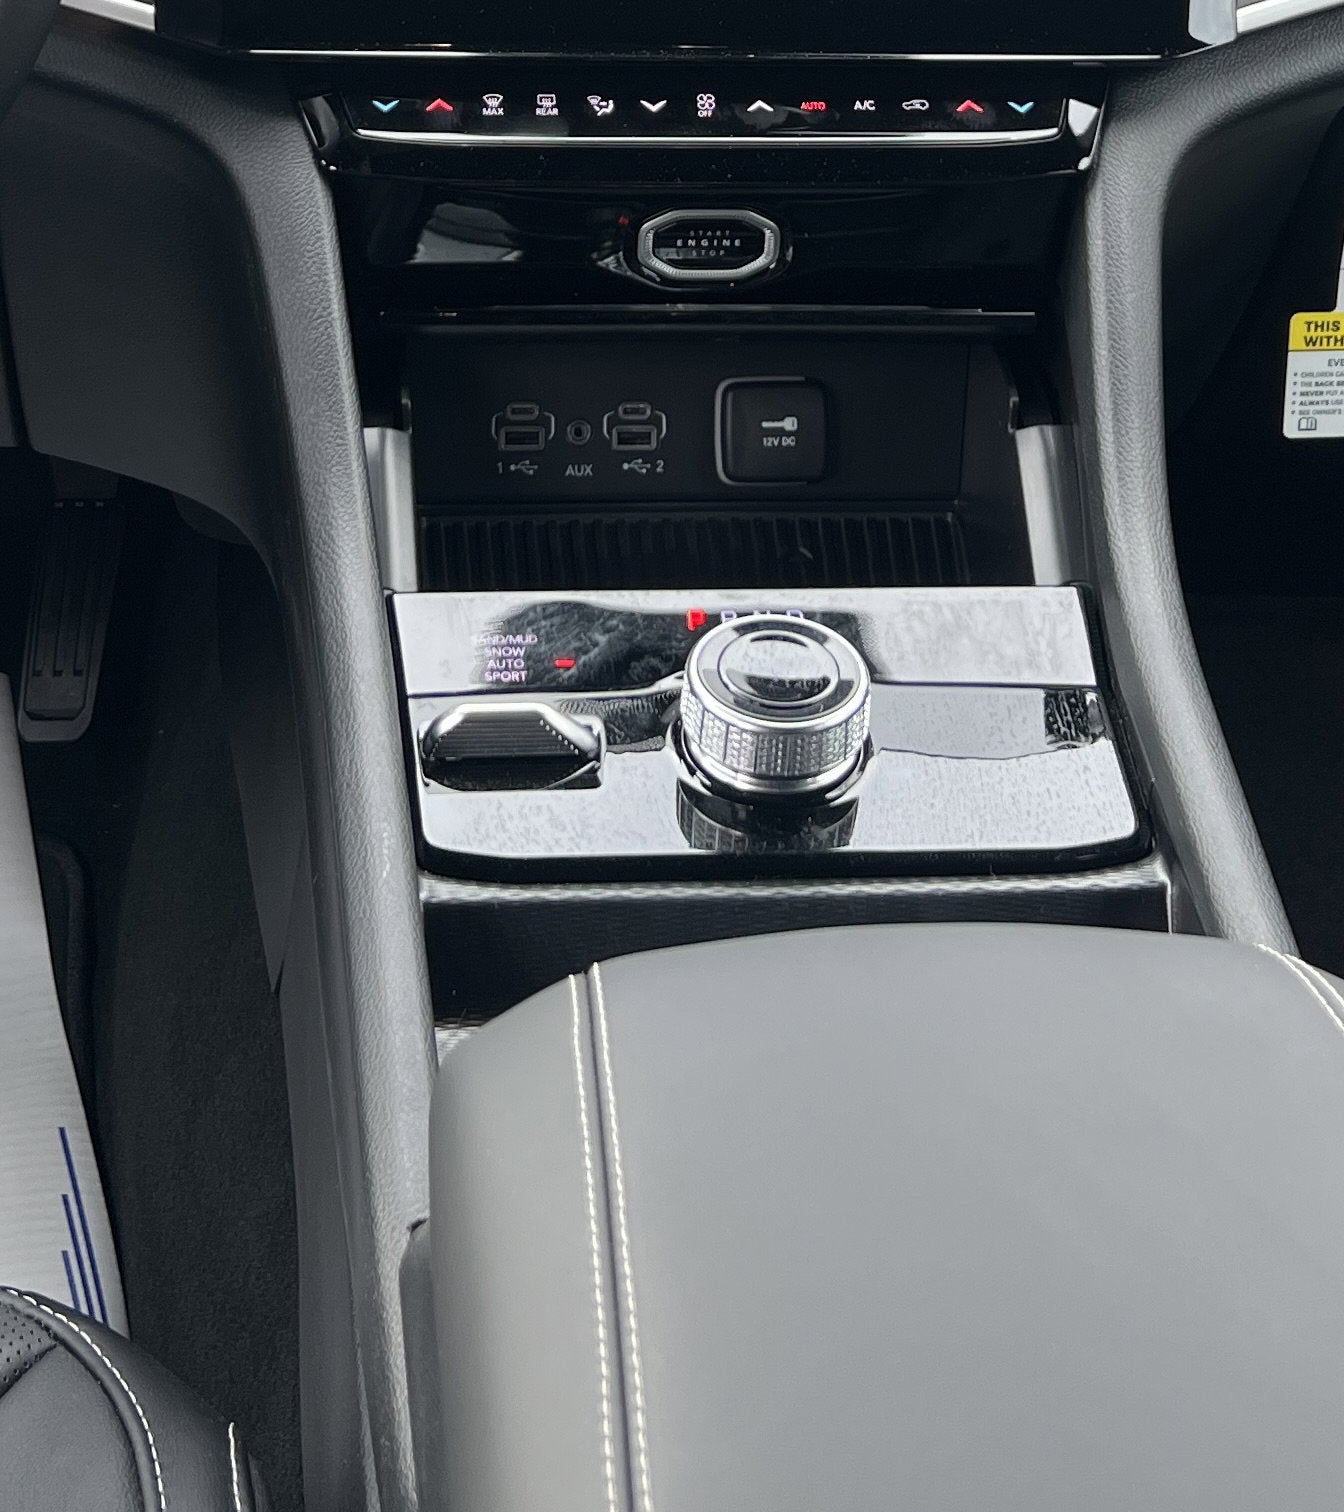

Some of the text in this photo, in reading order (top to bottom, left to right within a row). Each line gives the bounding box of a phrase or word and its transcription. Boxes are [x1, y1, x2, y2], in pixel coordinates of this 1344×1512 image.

[482, 105, 505, 116] MAX
[535, 105, 559, 116] REAR
[800, 101, 827, 112] AUTO
[853, 100, 876, 111] A/C
[697, 109, 714, 119] OFF
[689, 229, 731, 237] START
[676, 239, 742, 247] ENGINE
[692, 249, 726, 257] STOP
[1304, 320, 1341, 333] THIS
[1304, 334, 1344, 347] WITH
[762, 436, 796, 448] 12V DC
[496, 461, 504, 474] 1
[565, 464, 593, 477] AUX
[656, 460, 665, 473] 2
[686, 609, 707, 632] P
[484, 646, 526, 658] SNOW
[487, 658, 525, 669] AUTO
[484, 670, 528, 682] SPORT
